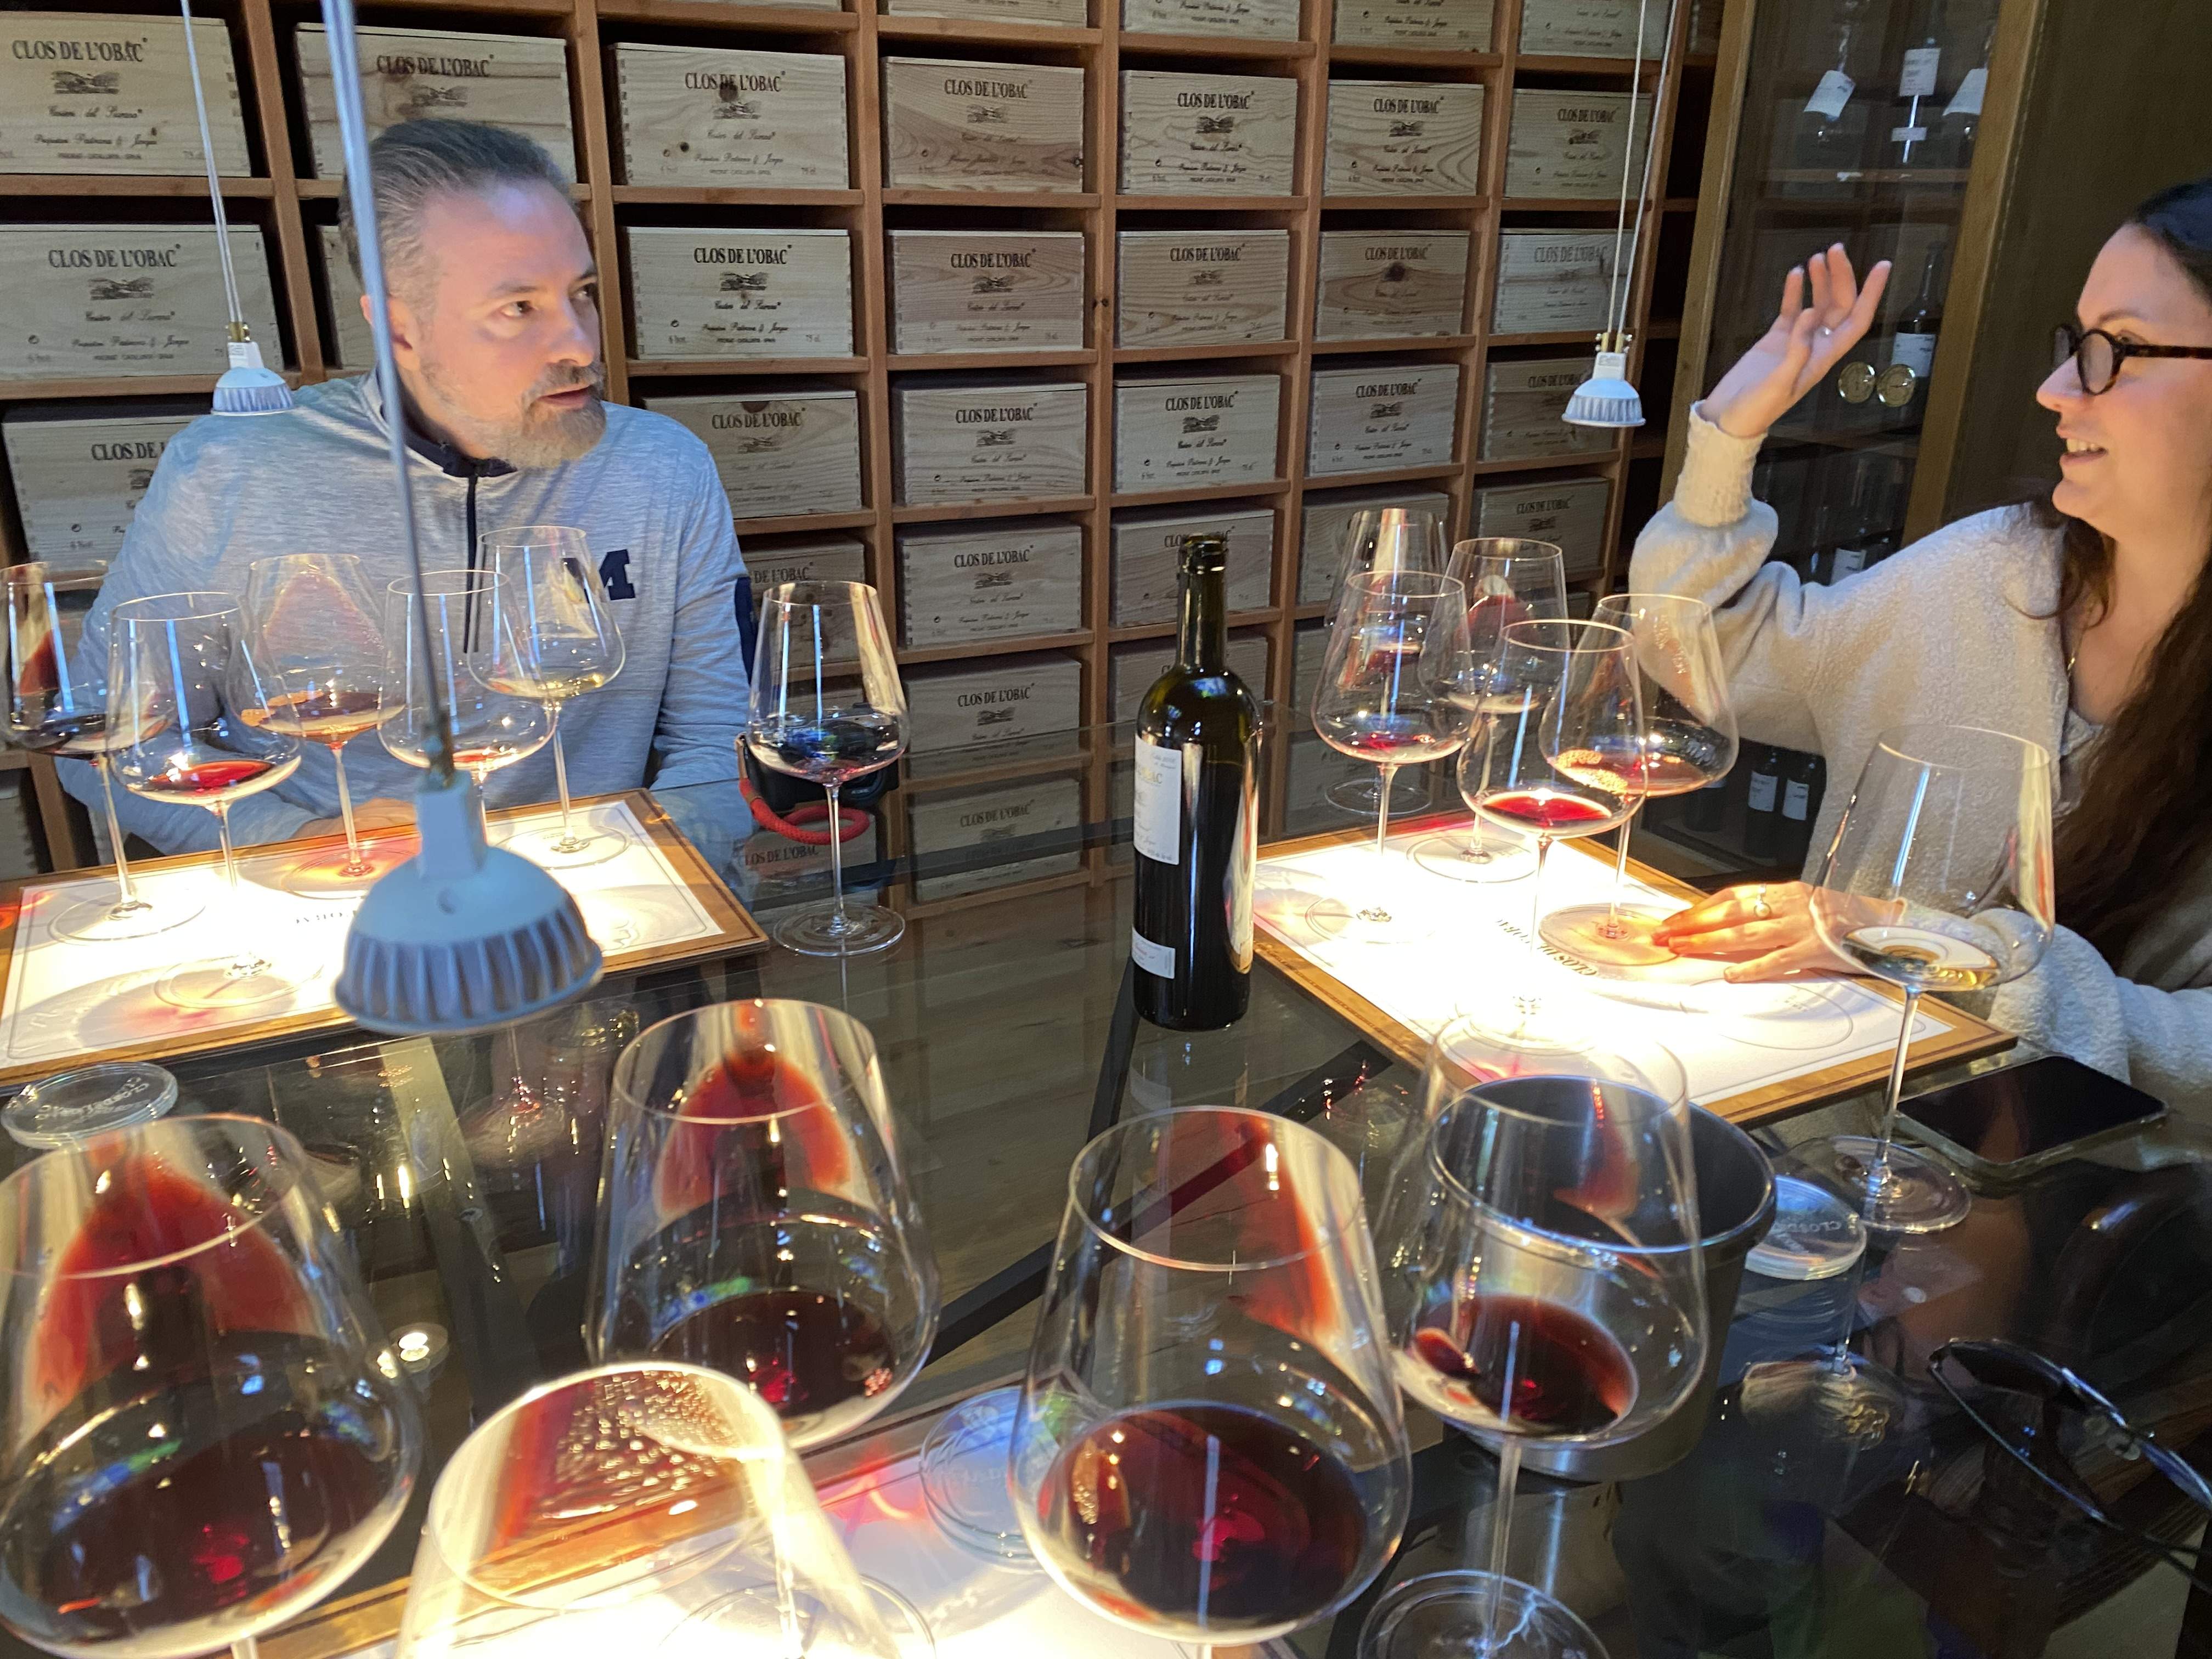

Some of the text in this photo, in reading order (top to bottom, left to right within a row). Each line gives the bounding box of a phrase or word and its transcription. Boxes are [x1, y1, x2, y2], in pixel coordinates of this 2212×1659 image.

[12, 40, 144, 62] CLOS DE L'OBAC
[685, 72, 718, 89] CLOS
[740, 75, 782, 92] L'OBAC
[944, 79, 972, 95] CLOS
[975, 80, 989, 97] DE
[1177, 93, 1202, 108] CLOS
[1204, 94, 1217, 108] DE
[49, 250, 177, 268] CLOS DE L'OBAC
[694, 248, 787, 264] CLOS DE L'OBAC
[951, 253, 1031, 268] CLOS DE L'OBAC
[1170, 247, 1241, 261] CLOS DE L'OBAC
[1166, 395, 1234, 411] CLOS DE L'OBAC
[712, 414, 742, 429] CLOS
[745, 413, 761, 428] DE
[956, 408, 1033, 423] CLOS DE L'OBAC
[92, 443, 132, 460] CLOS
[136, 442, 156, 459] DE
[1165, 534, 1183, 548] CLO
[955, 549, 1030, 568] CLOS DE L'OBAC
[755, 570, 767, 583] DE
[958, 687, 1031, 707] CLOS DE L'OBAC
